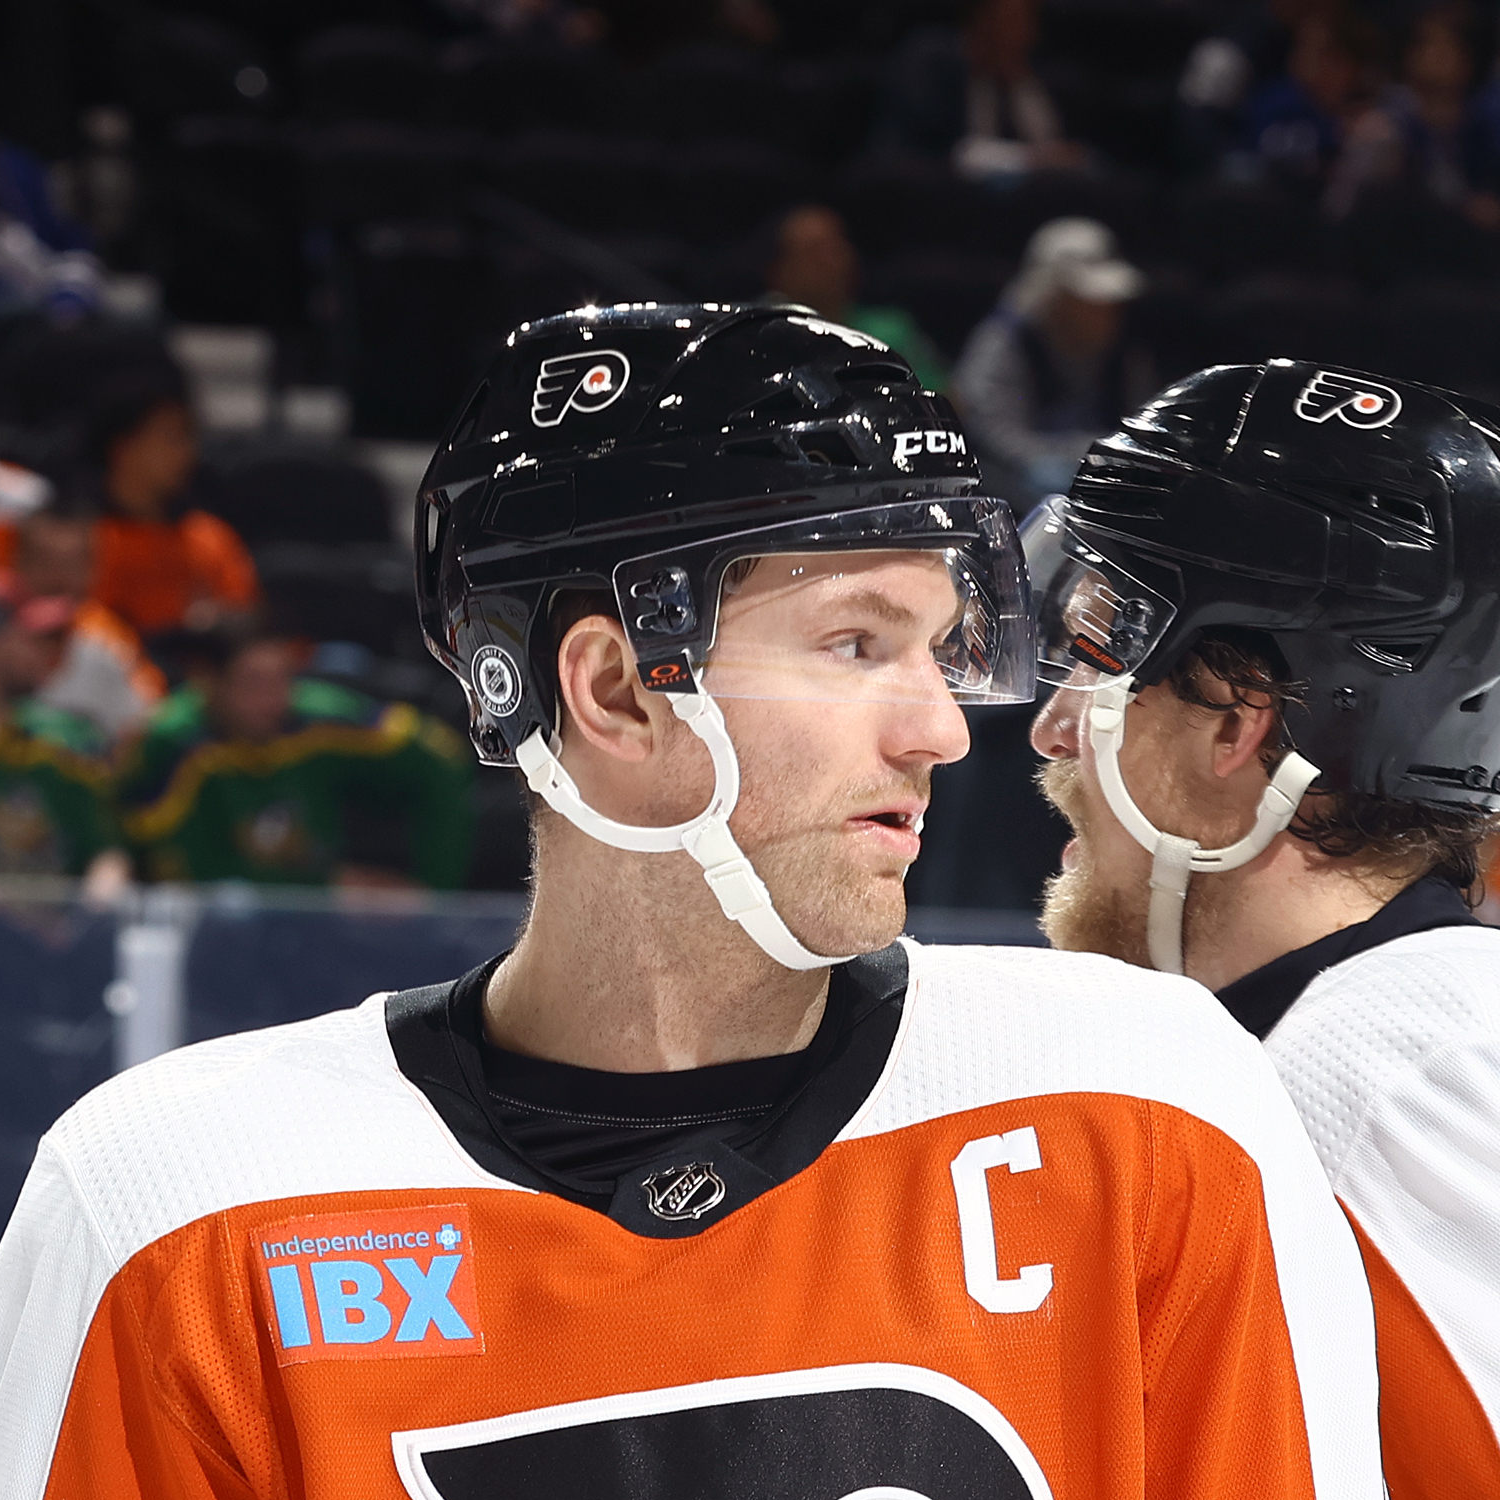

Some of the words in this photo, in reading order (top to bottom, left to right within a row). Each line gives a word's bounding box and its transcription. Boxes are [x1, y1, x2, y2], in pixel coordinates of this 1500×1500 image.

[892, 430, 967, 457] CCM
[262, 1230, 430, 1260] Independence
[948, 1126, 1055, 1315] C
[268, 1254, 475, 1349] IBX
